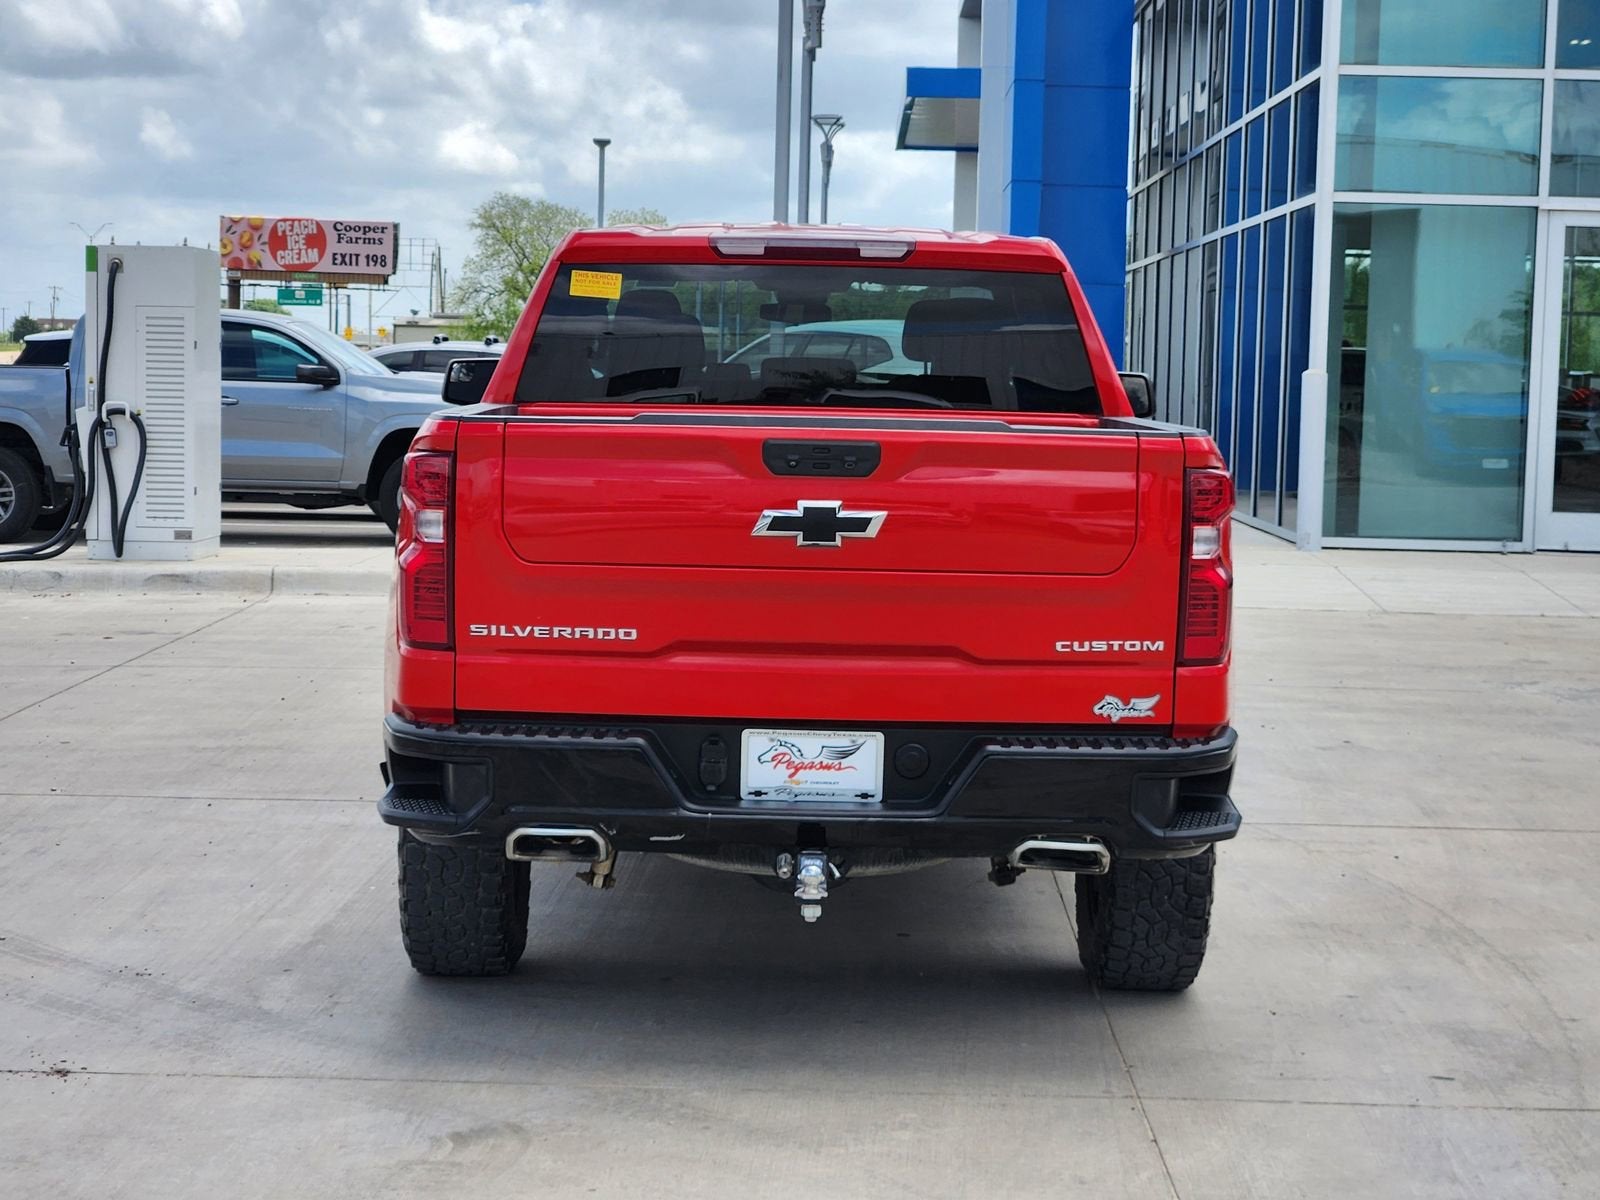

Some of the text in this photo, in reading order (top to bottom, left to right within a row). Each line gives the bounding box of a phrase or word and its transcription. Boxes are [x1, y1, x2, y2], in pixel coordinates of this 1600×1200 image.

[276, 219, 318, 236] PEACH
[333, 221, 388, 236] Cooper
[287, 235, 306, 249] ICE
[336, 233, 384, 245] Farms
[276, 248, 319, 265] CREAM
[331, 252, 387, 268] EXIT 198
[591, 273, 619, 281] VEHICLE
[469, 624, 638, 641] SILVERADO
[1055, 640, 1165, 652] CUSTOM
[771, 752, 858, 779] Pegasus
